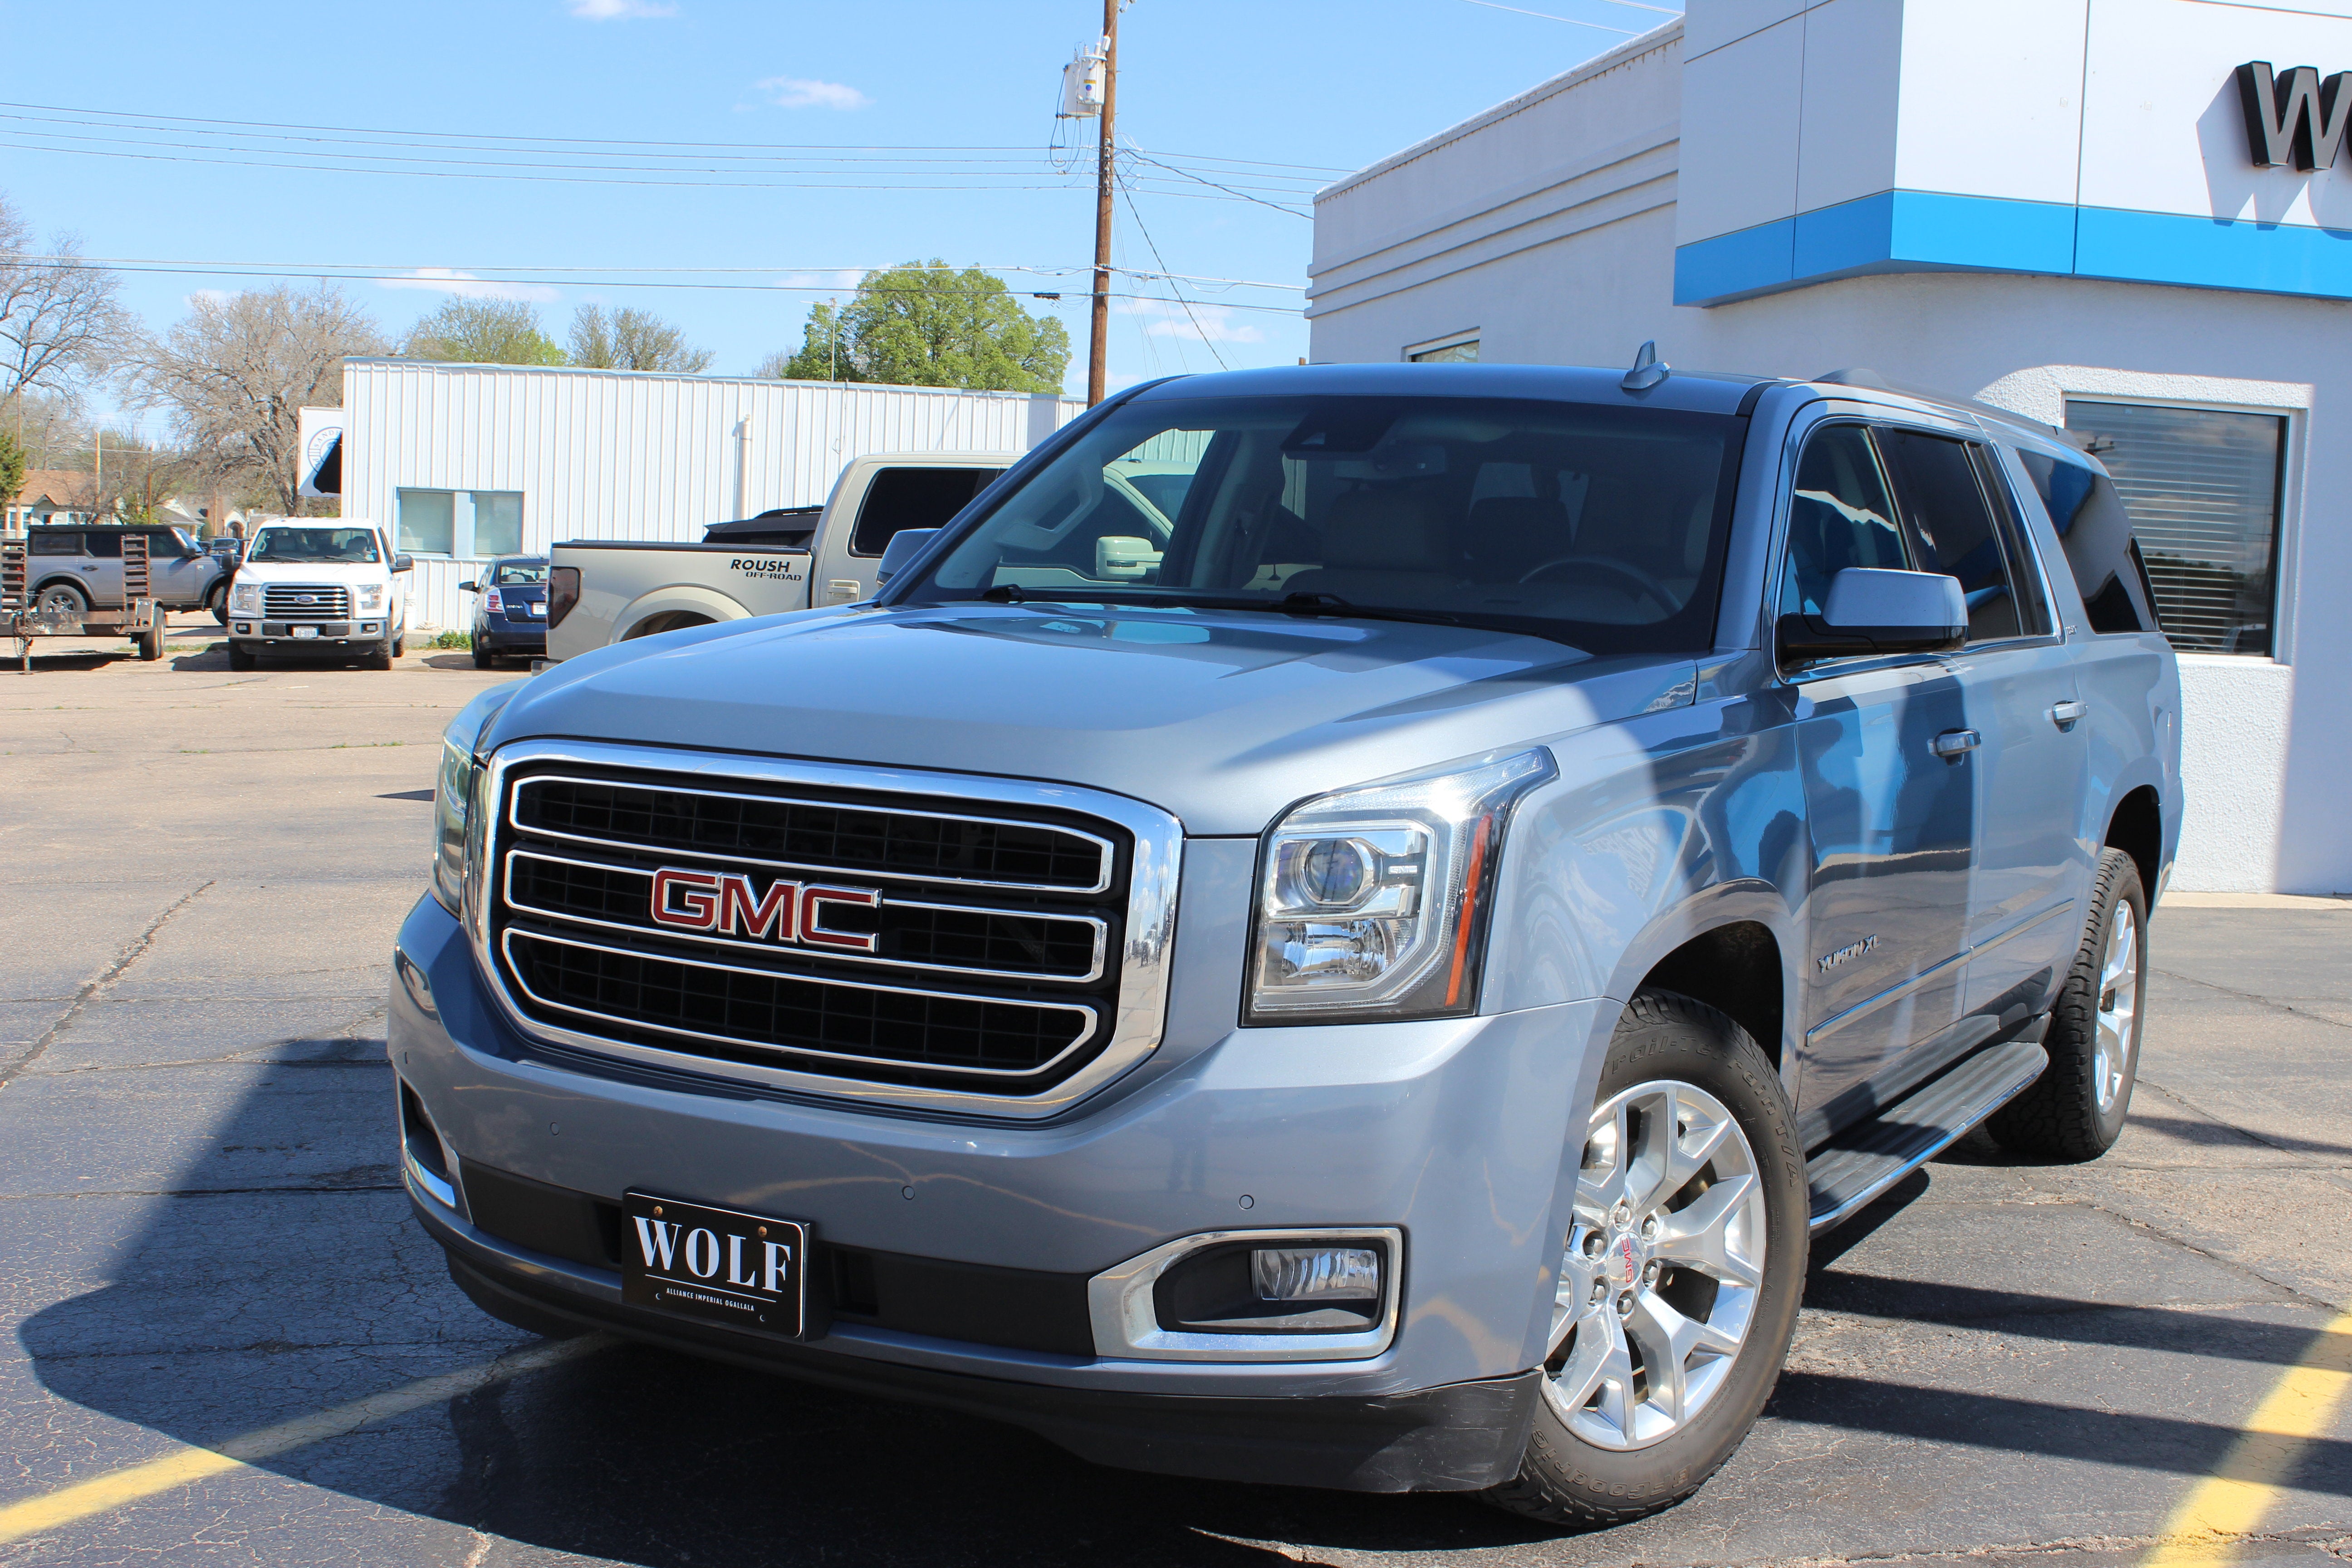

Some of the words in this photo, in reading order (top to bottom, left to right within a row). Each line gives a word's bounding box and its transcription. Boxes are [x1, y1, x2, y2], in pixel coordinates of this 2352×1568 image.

[2236, 60, 2352, 172] W
[730, 559, 790, 573] ROUSH
[745, 571, 802, 581] OFF-ROAD
[651, 866, 882, 953] GMC
[1818, 940, 1864, 974] YUKON
[1862, 934, 1882, 954] XL
[632, 1215, 791, 1293] WOLF
[1621, 1237, 1633, 1284] GMC
[666, 1287, 694, 1299] ALLIANCE
[695, 1293, 723, 1305] IMPERIAL
[725, 1299, 755, 1312] OGALLALA
[1531, 1419, 1691, 1499] BFGoodric
